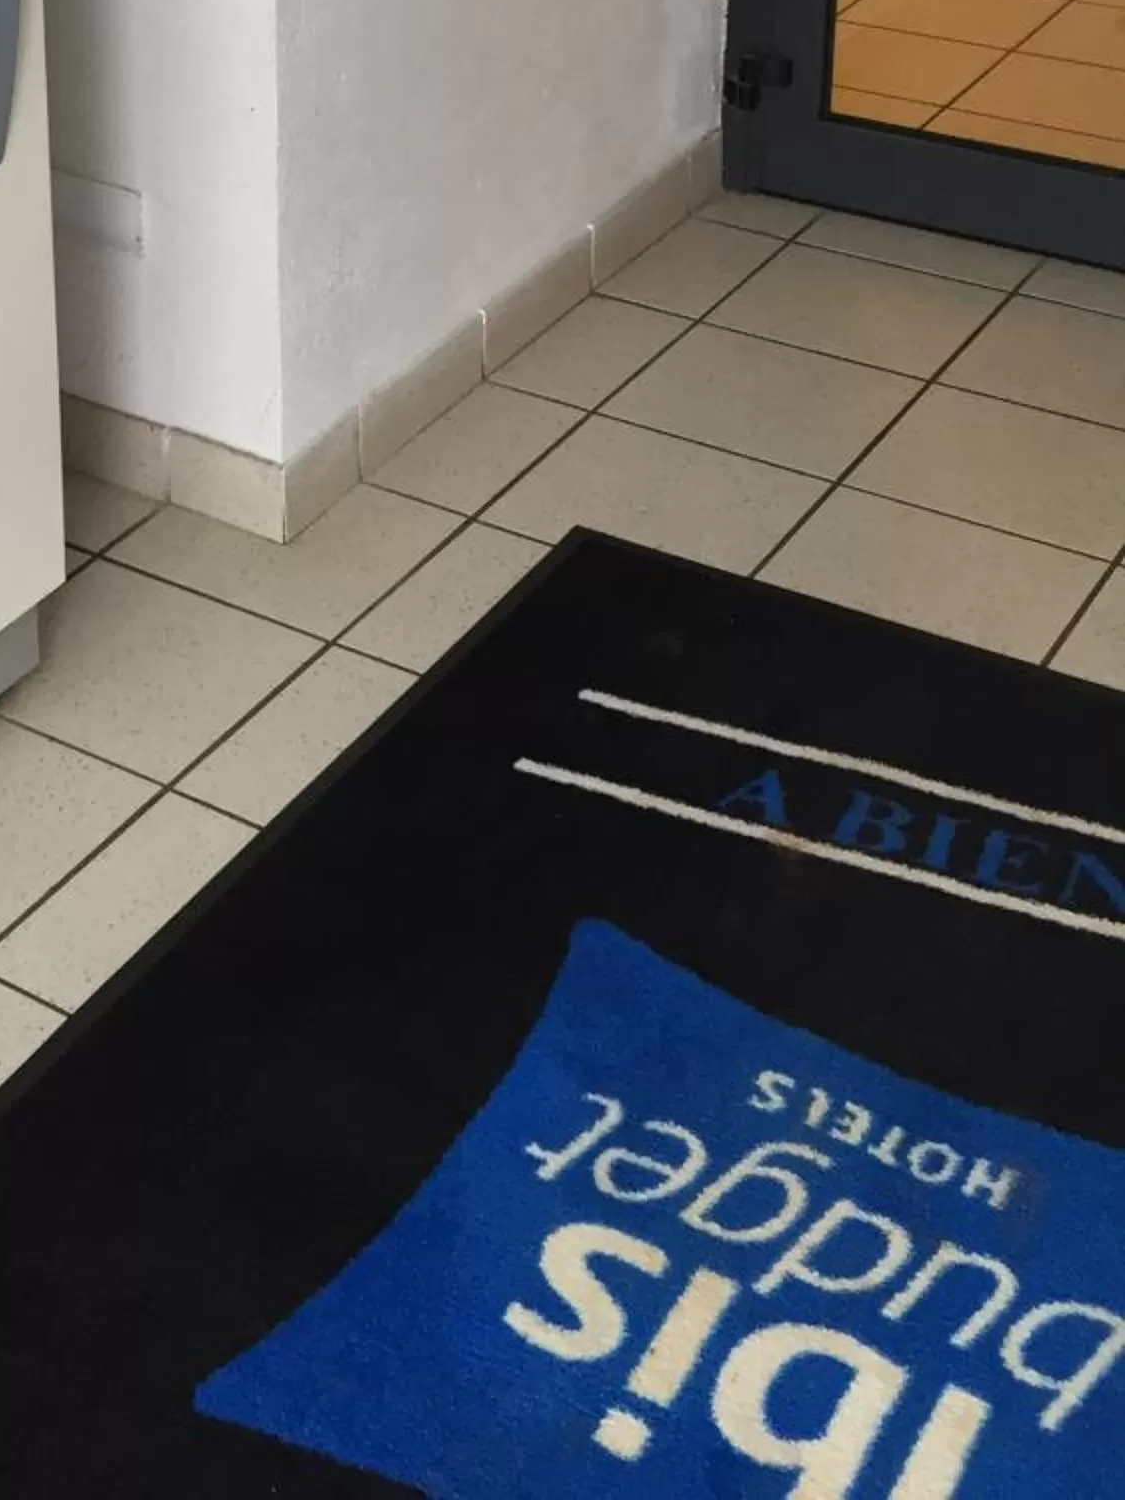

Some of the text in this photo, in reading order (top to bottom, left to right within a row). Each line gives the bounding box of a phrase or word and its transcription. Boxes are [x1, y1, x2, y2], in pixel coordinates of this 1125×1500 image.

[713, 769, 790, 828] A
[748, 1068, 1022, 1209] HOTELS
[525, 1091, 1125, 1432] budget
